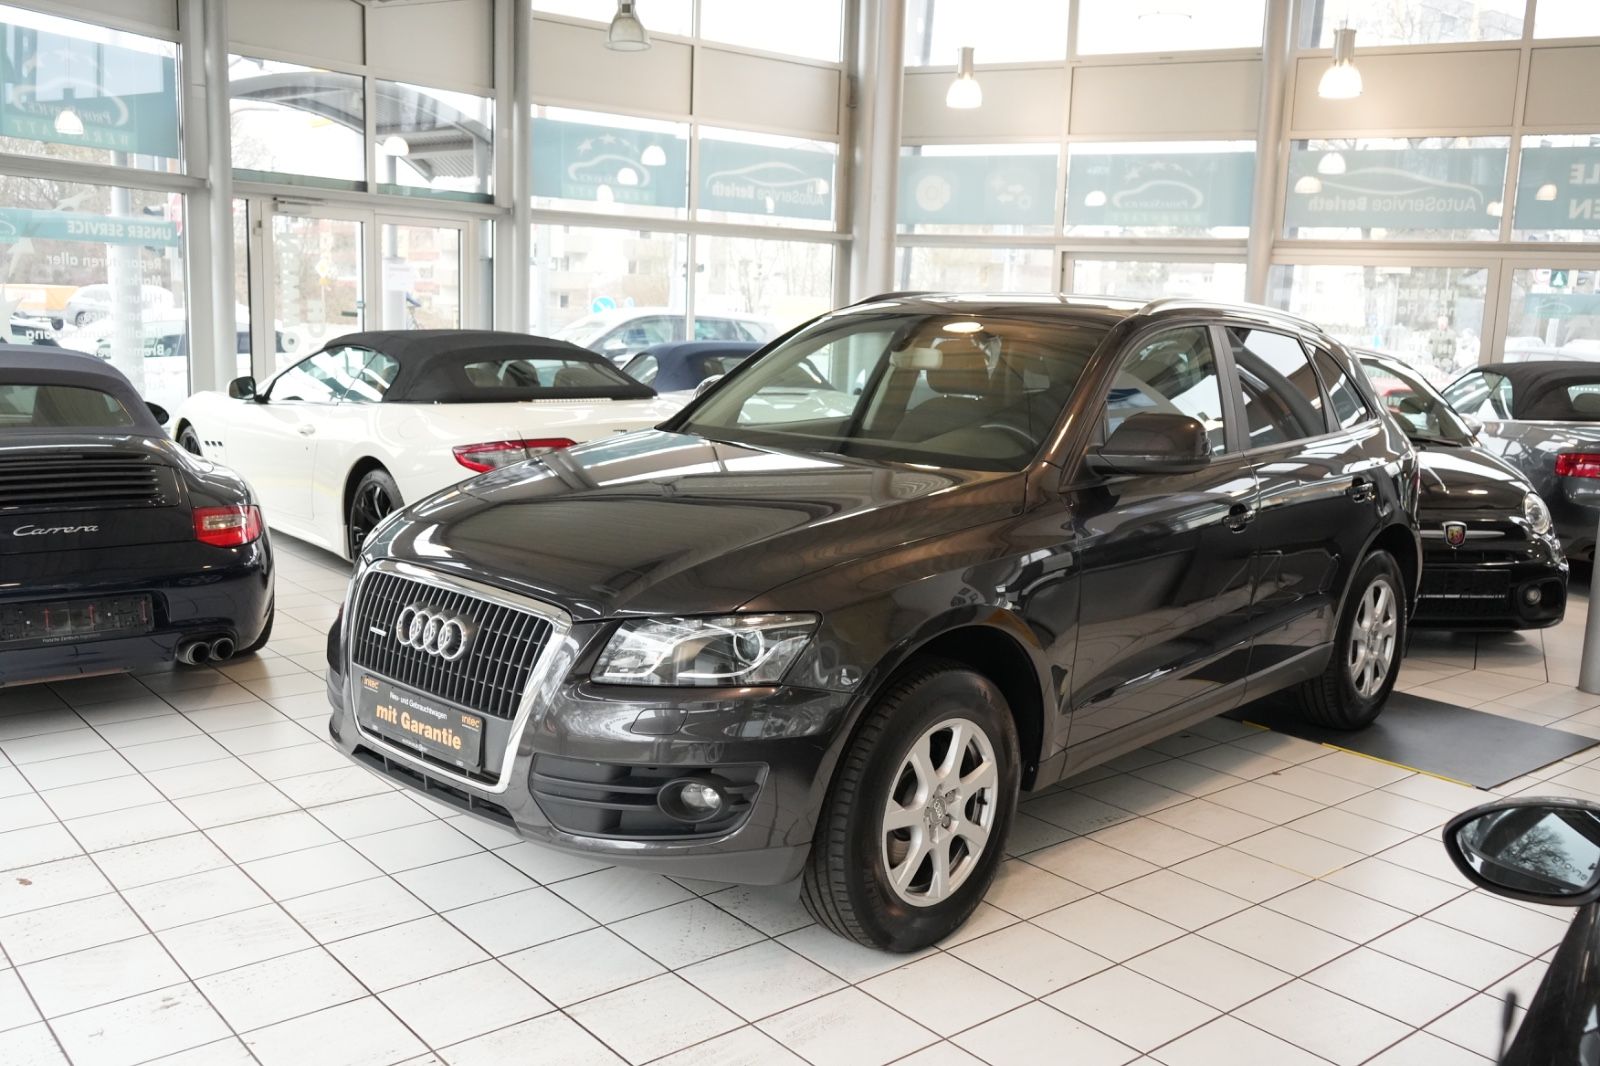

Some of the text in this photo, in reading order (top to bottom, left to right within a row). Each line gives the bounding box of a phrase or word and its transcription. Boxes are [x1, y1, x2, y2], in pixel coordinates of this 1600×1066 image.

[13, 524, 99, 537] Carrera
[400, 695, 409, 706] und
[409, 699, 448, 720] Gebrauchtwagen
[376, 704, 398, 725] mit
[400, 712, 462, 751] Garantie
[461, 714, 480, 729] intec
